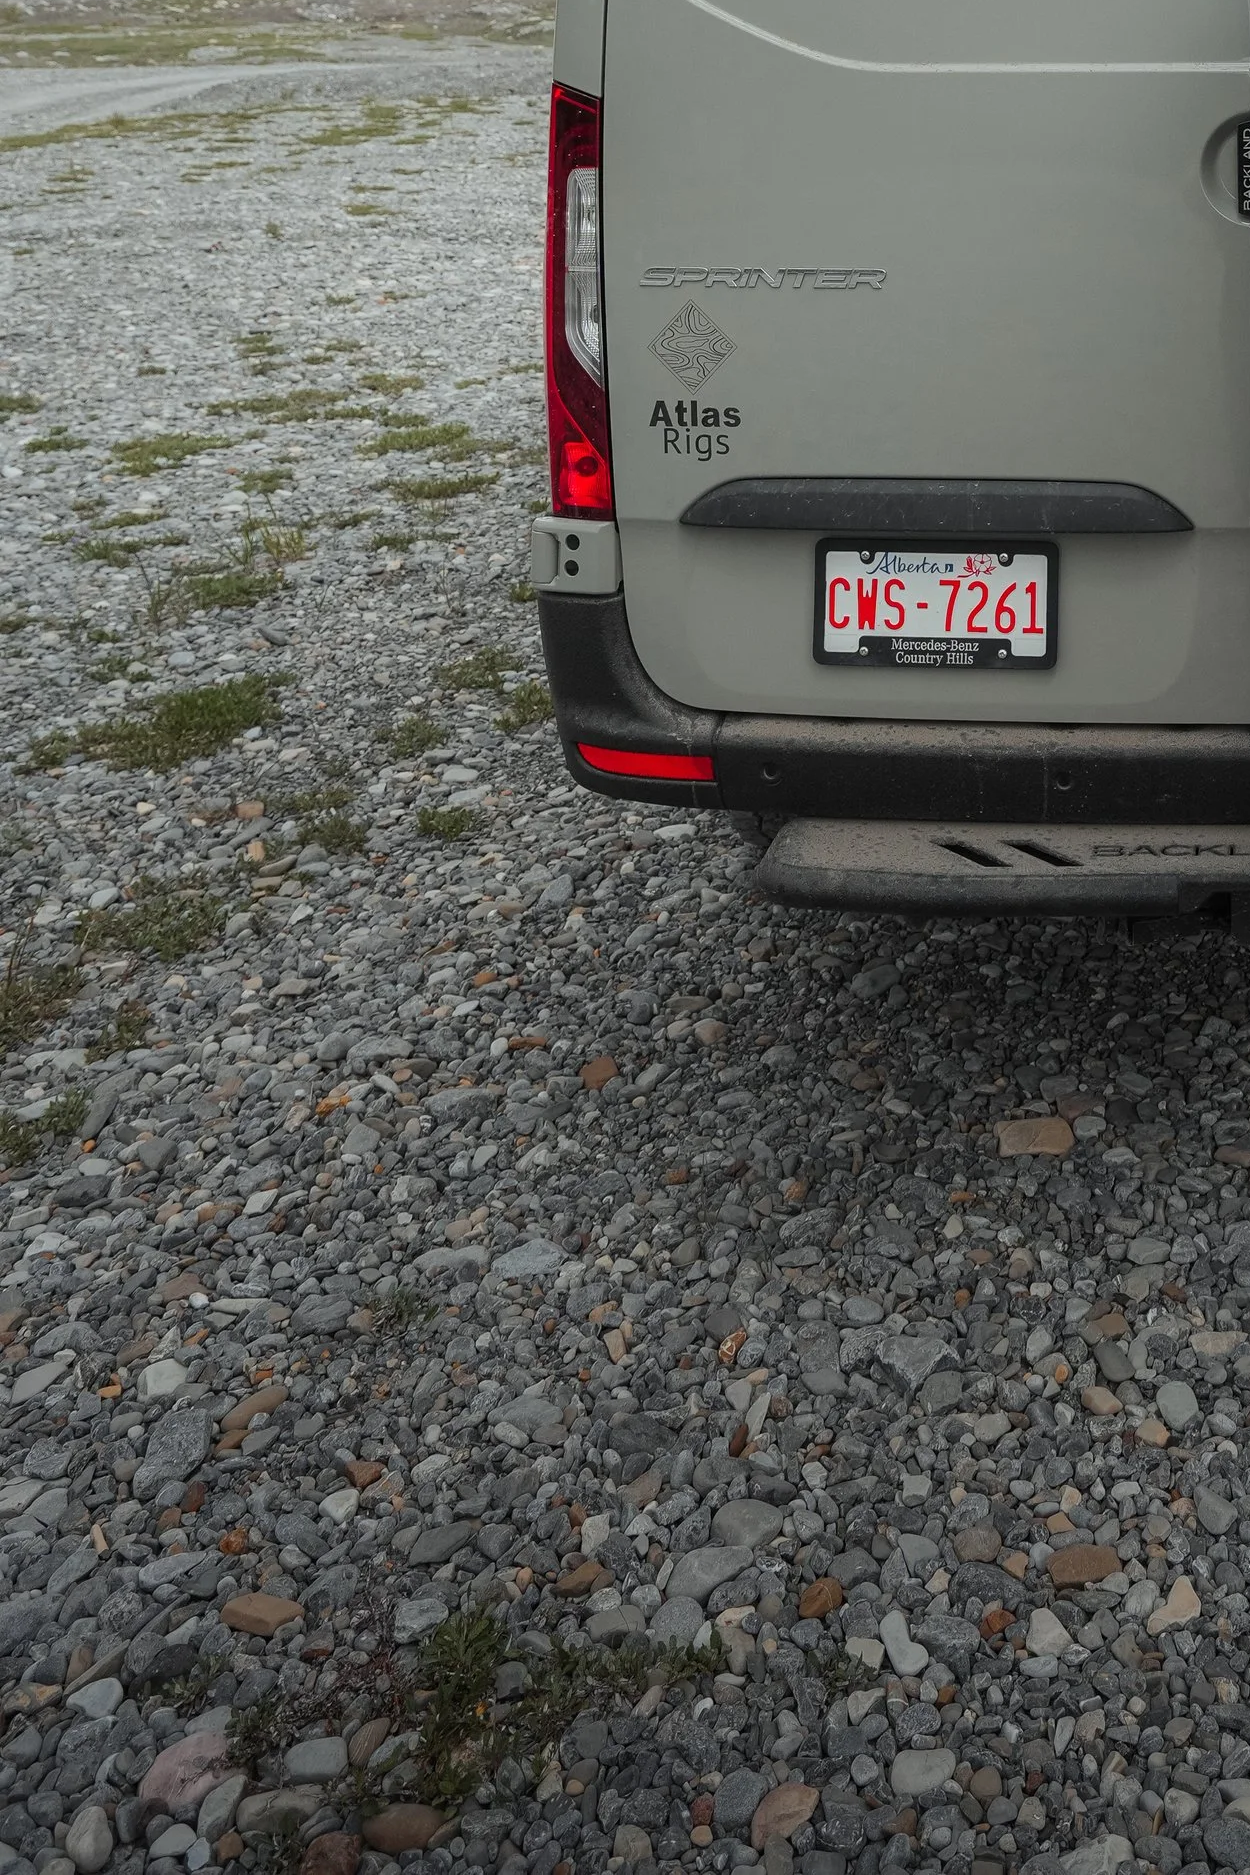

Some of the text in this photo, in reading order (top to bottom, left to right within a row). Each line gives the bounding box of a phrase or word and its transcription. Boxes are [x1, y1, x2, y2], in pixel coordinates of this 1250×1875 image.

[639, 266, 888, 290] SPRINTER
[649, 400, 742, 428] Atlas
[663, 427, 731, 462] Rigs
[866, 552, 947, 575] Alberta
[828, 577, 1045, 635] CWS-7261
[890, 638, 980, 653] Mercedes-Benz
[895, 652, 974, 668] Country Hills
